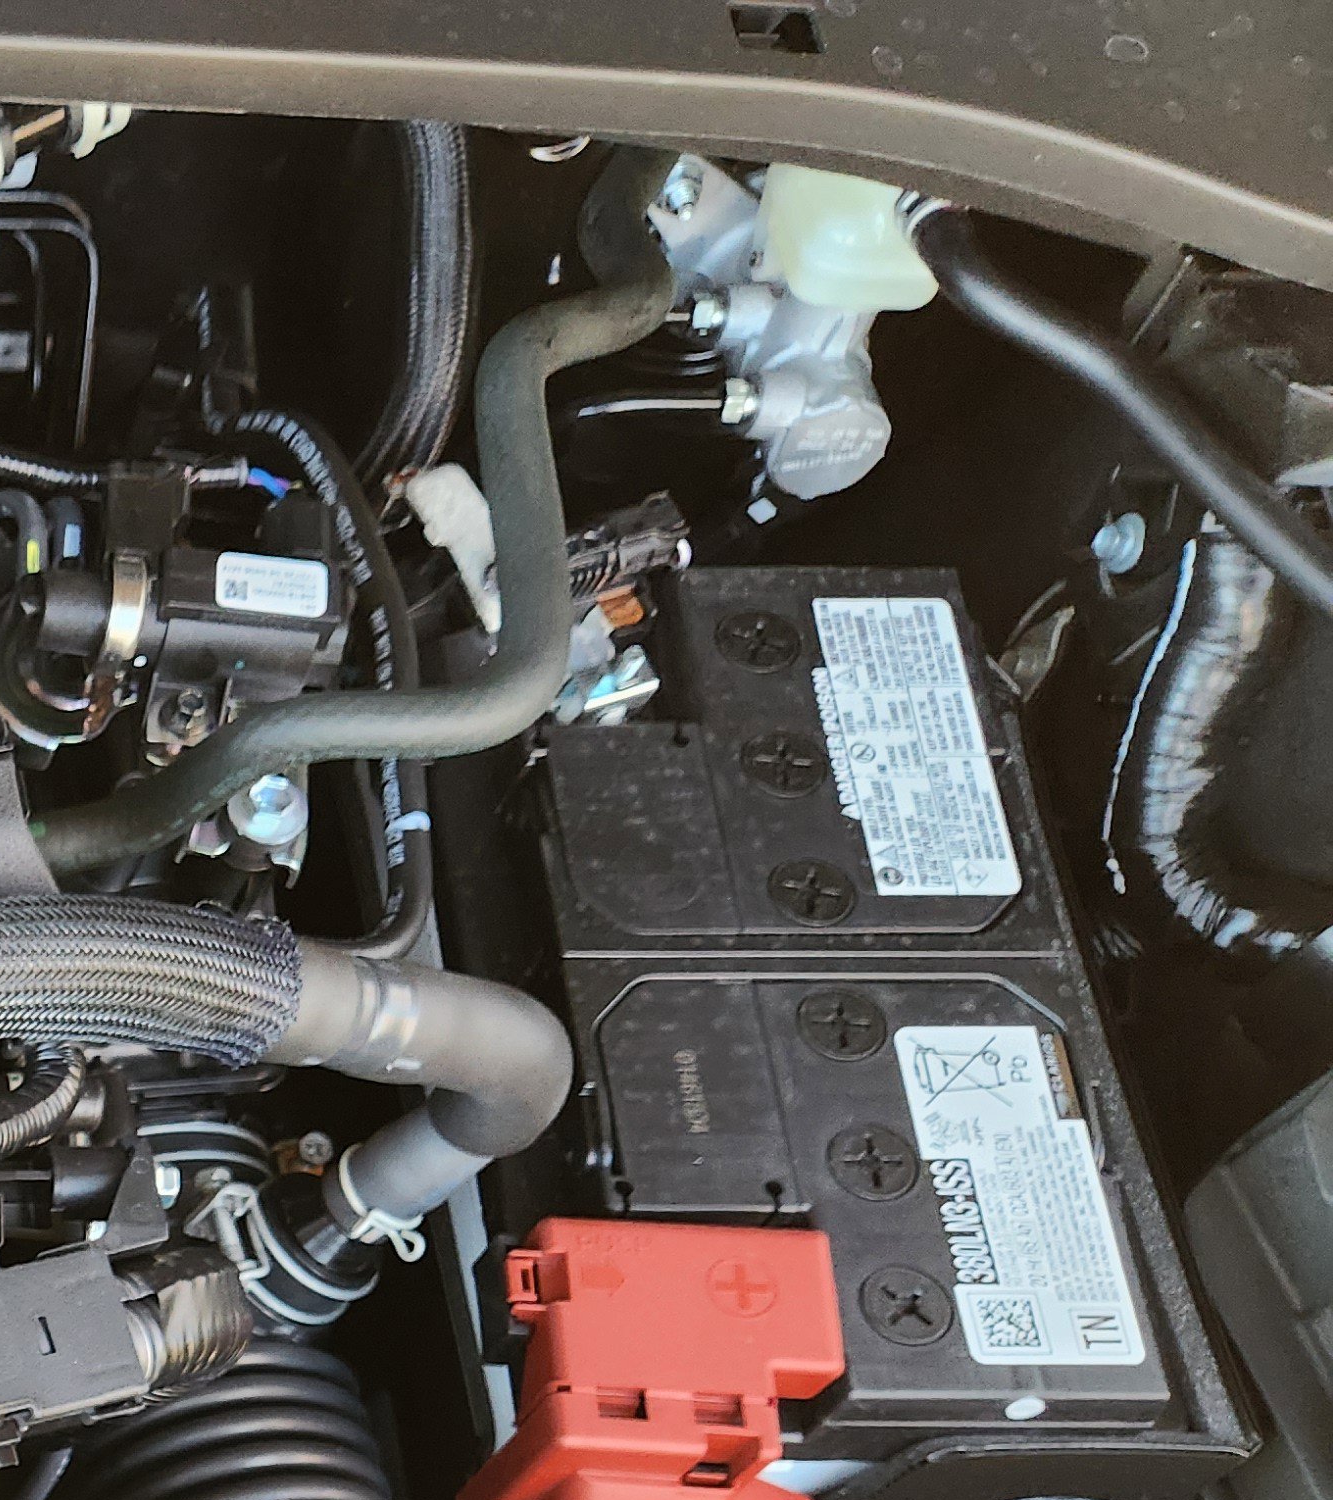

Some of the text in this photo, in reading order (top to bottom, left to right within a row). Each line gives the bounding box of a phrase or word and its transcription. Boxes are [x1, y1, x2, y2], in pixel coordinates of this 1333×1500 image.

[812, 666, 857, 805] DANGER/POISON
[1009, 1055, 1031, 1084] Pb
[1082, 1313, 1123, 1351] TN
